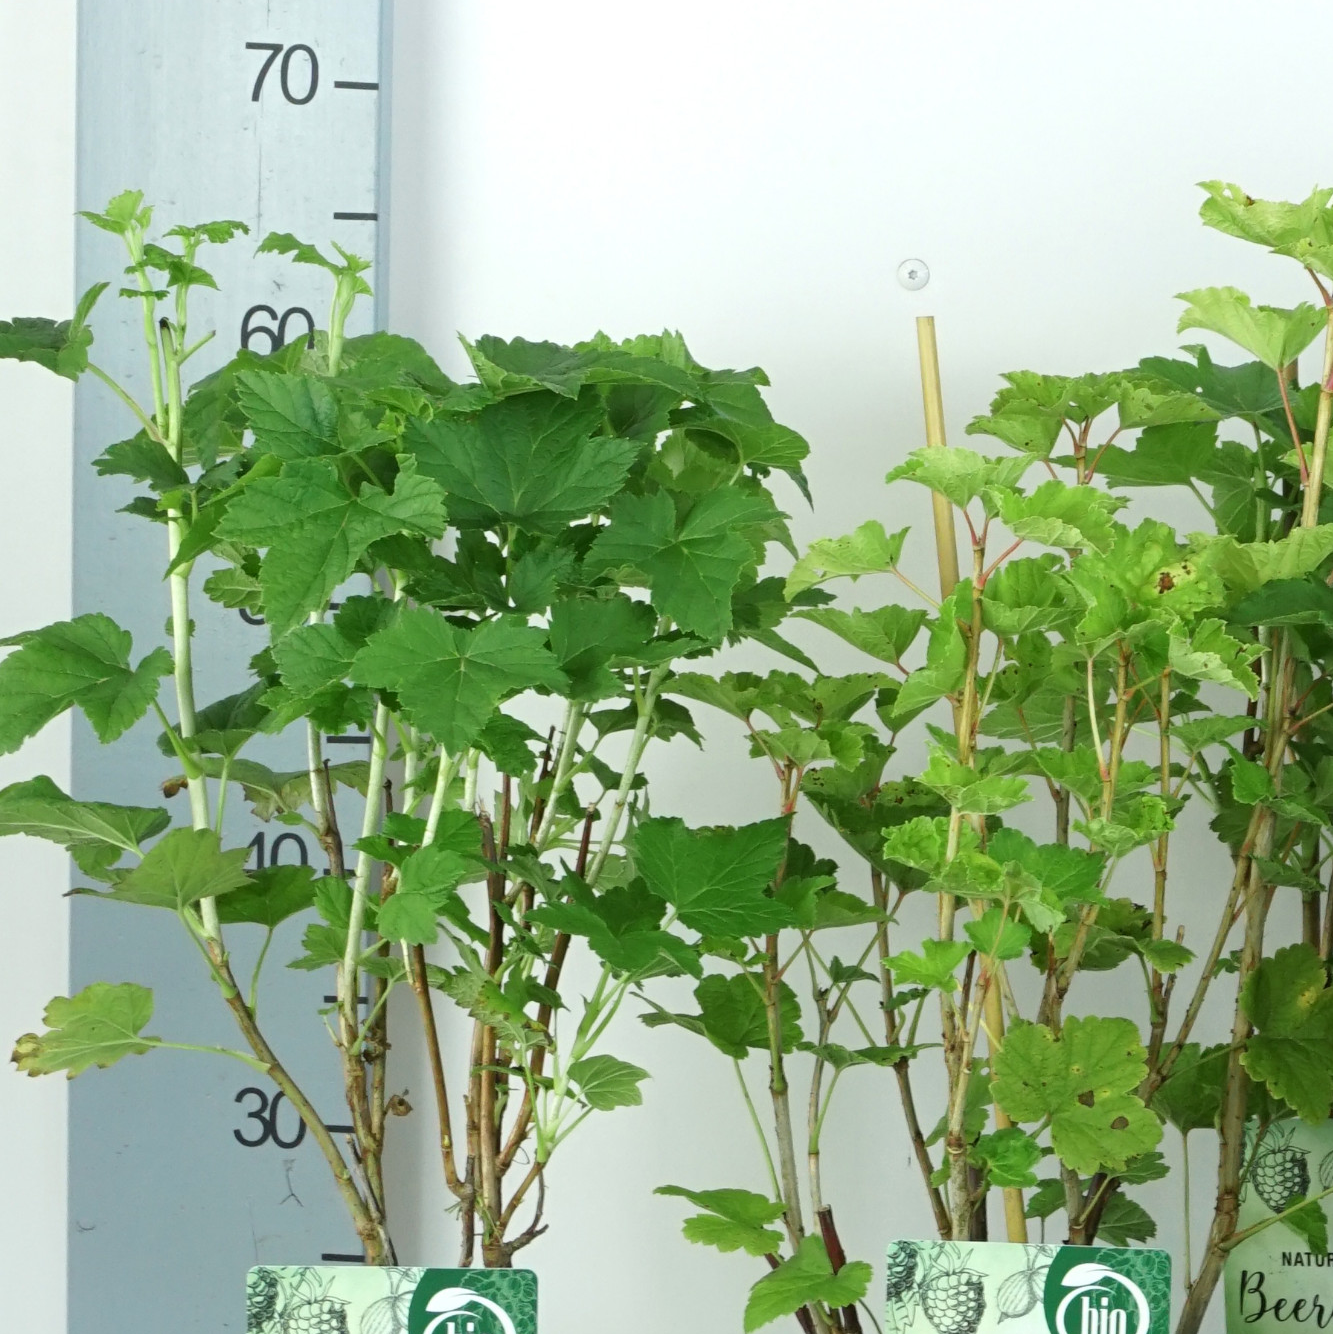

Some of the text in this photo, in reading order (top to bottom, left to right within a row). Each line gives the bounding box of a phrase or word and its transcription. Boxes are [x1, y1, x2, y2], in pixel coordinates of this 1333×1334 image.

[244, 42, 319, 105] 70
[241, 304, 315, 353] 60
[234, 1087, 306, 1149] 30
